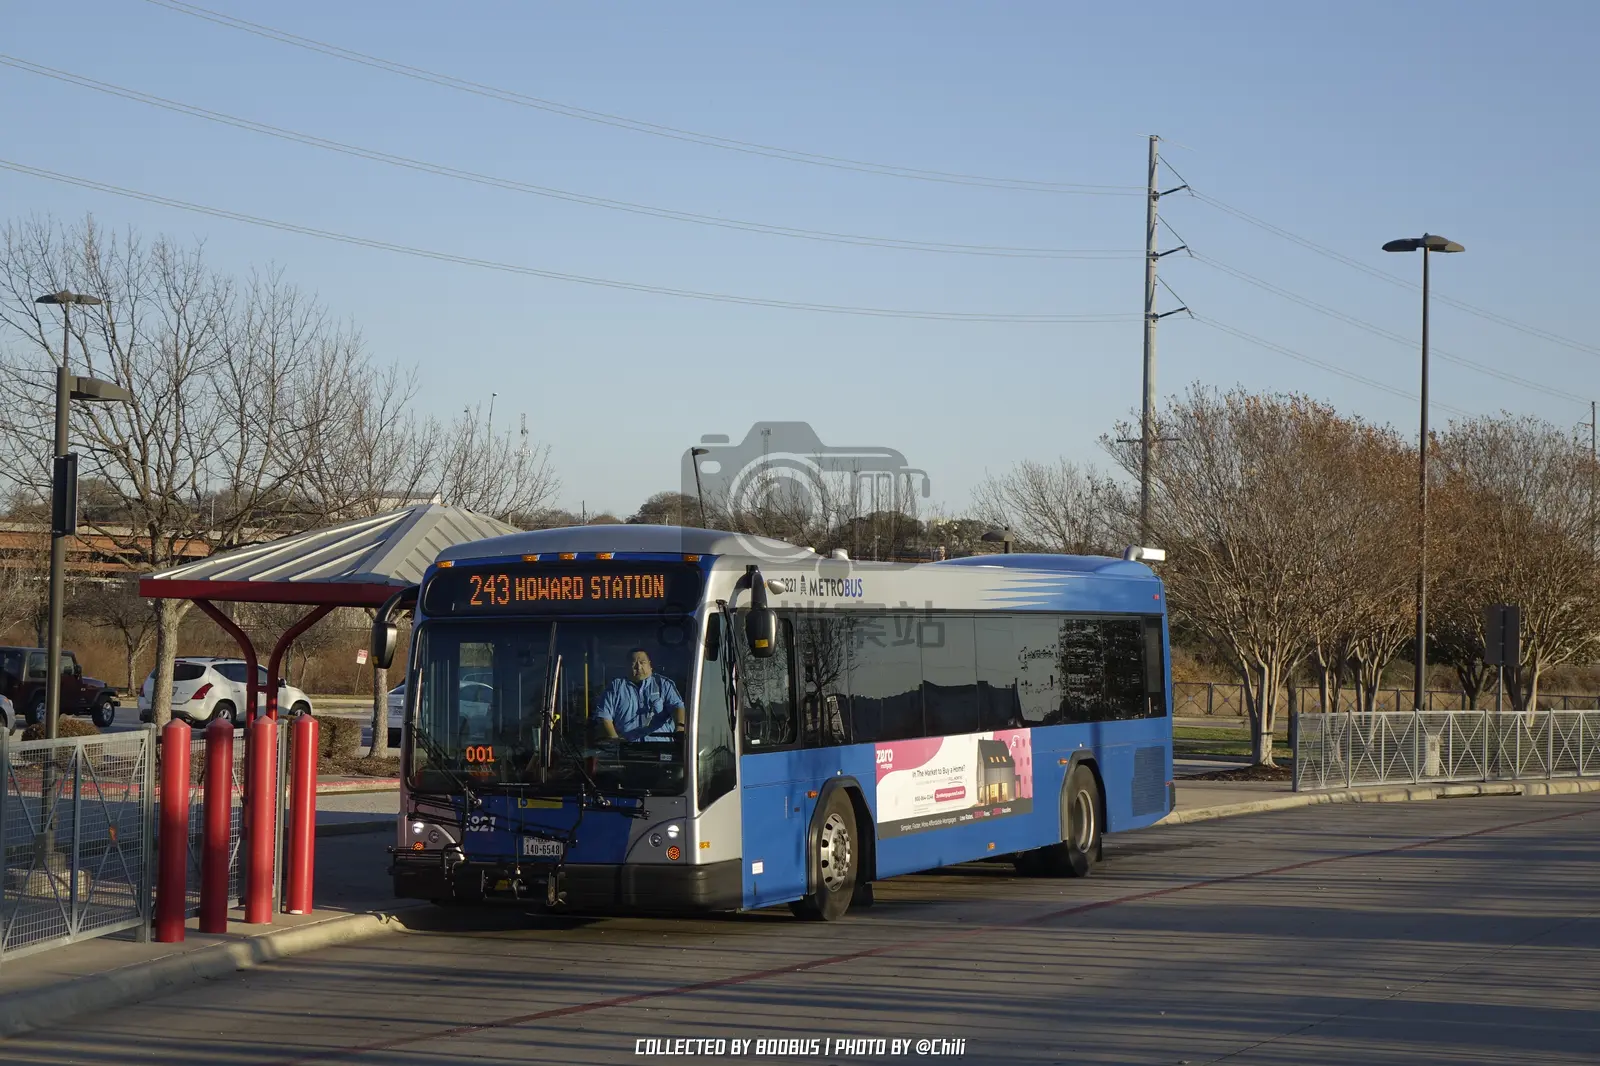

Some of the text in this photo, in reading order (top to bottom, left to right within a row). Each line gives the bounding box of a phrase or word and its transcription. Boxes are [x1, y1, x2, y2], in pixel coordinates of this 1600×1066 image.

[470, 574, 665, 605] 243 HOWARD STATION
[809, 577, 864, 598] METROBUS
[466, 745, 495, 762] 001
[875, 748, 894, 764] zero
[924, 768, 938, 776] Market
[942, 767, 950, 776] Buy
